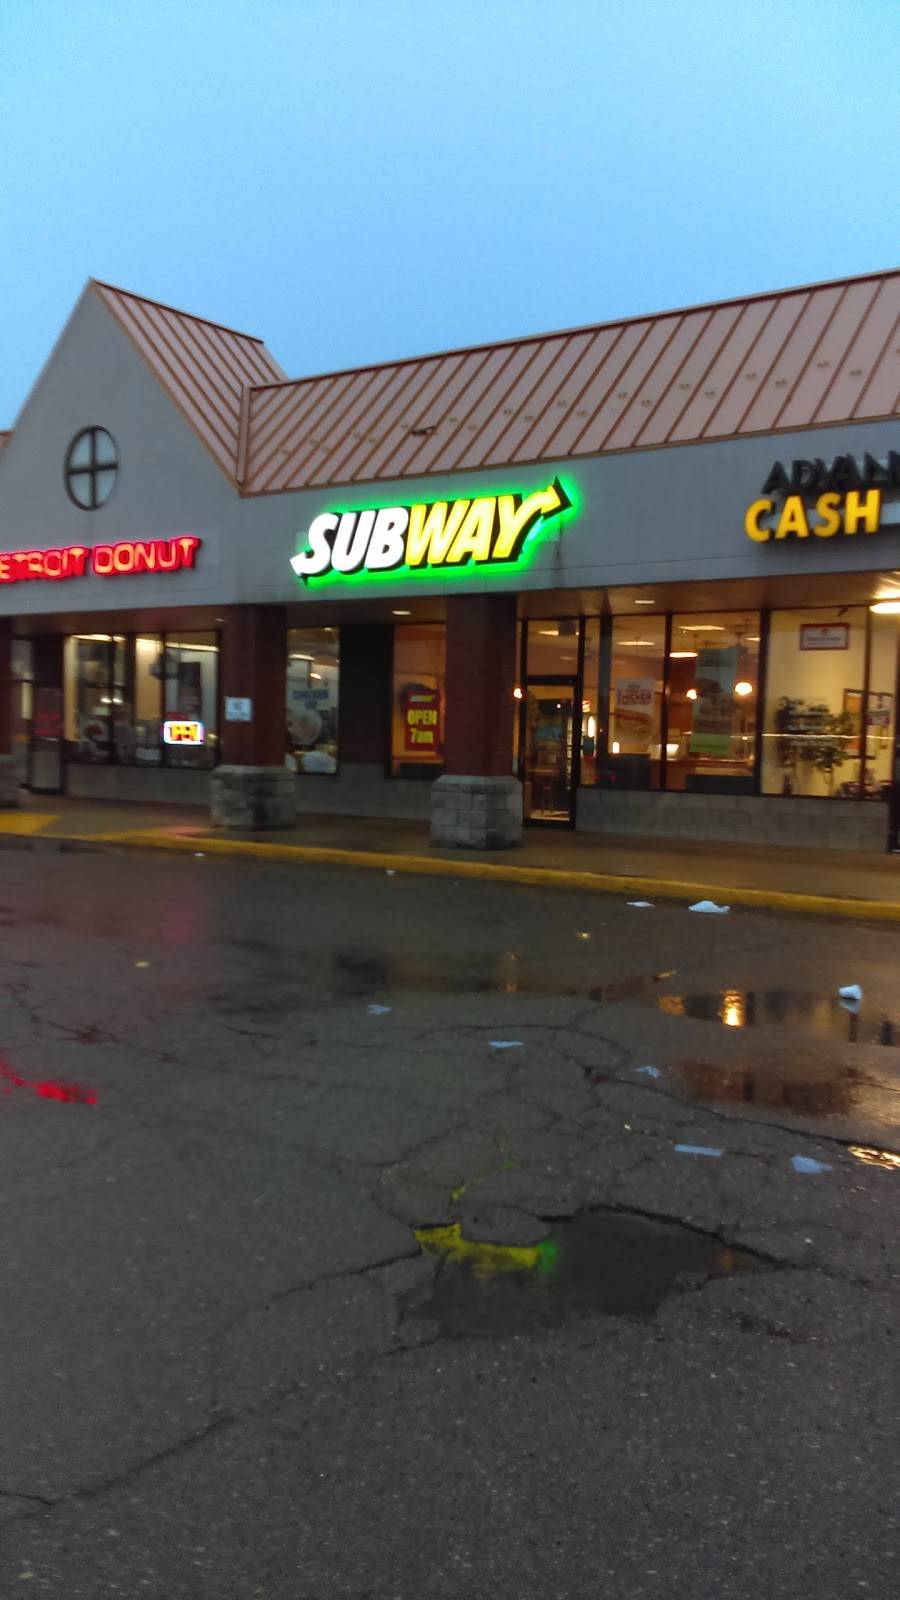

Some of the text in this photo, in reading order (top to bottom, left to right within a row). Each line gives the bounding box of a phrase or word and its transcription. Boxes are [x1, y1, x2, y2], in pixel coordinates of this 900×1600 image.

[289, 478, 572, 580] SUBWAY
[744, 488, 881, 543] CASH
[93, 537, 200, 575] DONUT
[407, 709, 438, 725] OPEN
